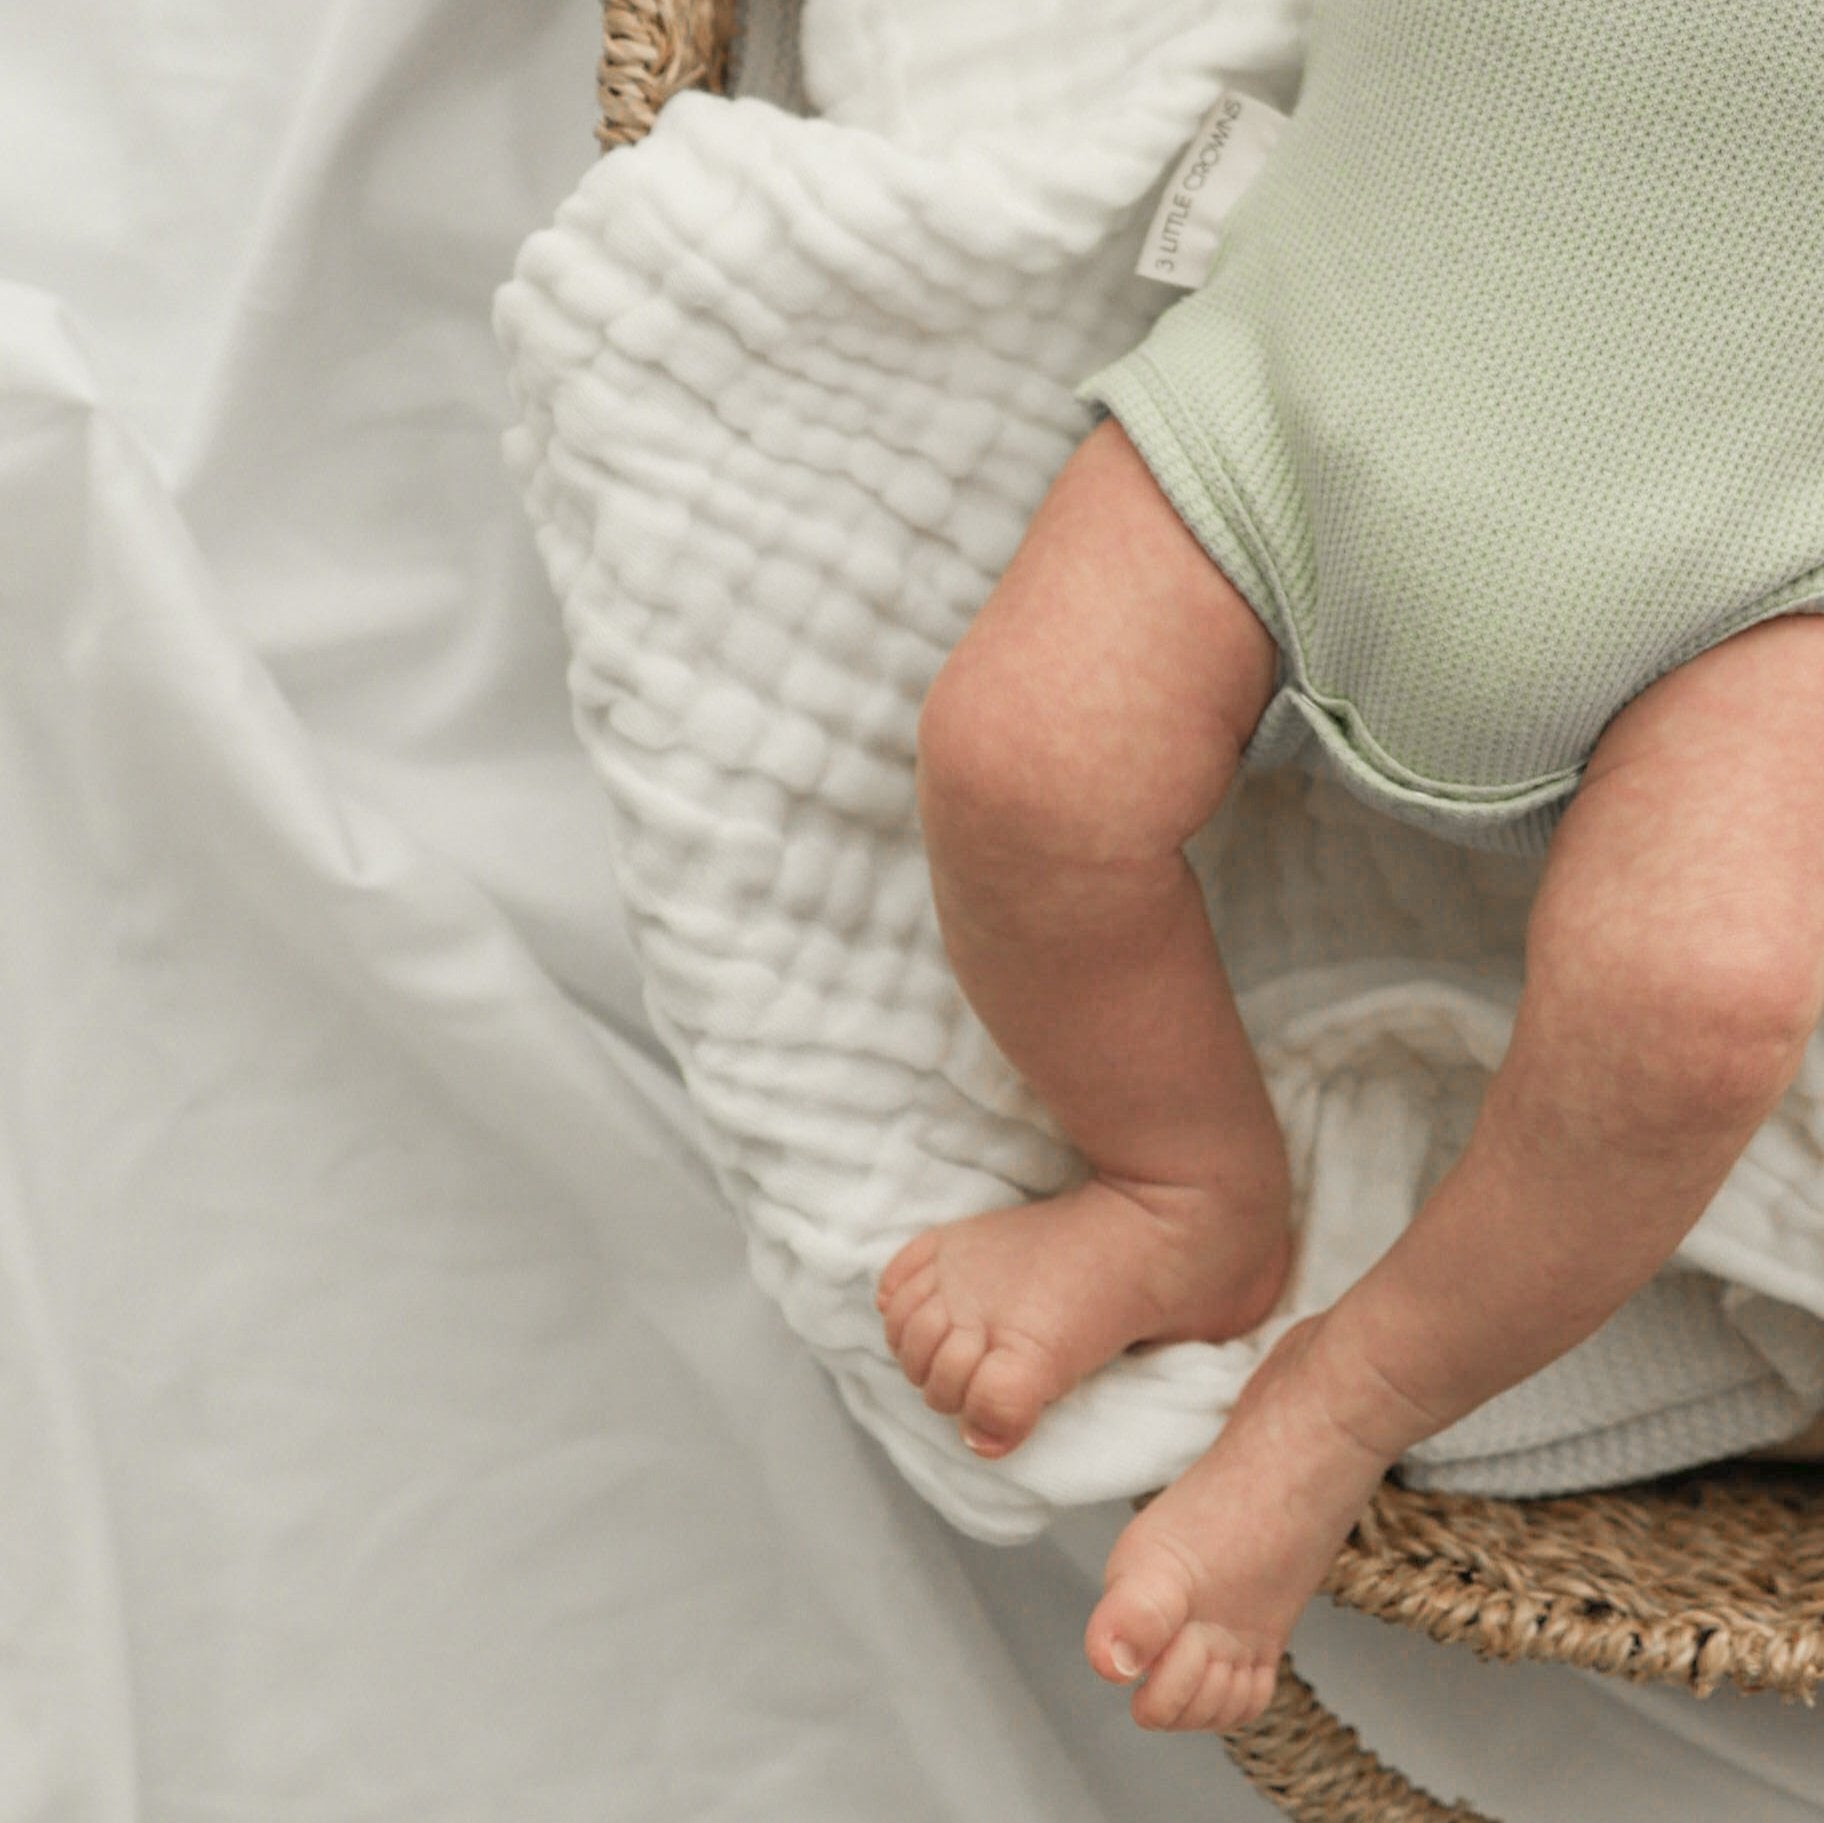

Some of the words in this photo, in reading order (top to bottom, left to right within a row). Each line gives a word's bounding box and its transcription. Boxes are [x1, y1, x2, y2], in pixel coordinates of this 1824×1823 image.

[1183, 100, 1242, 192] CROWNS
[1160, 194, 1192, 254] LITTLE
[1155, 258, 1175, 272] 3
